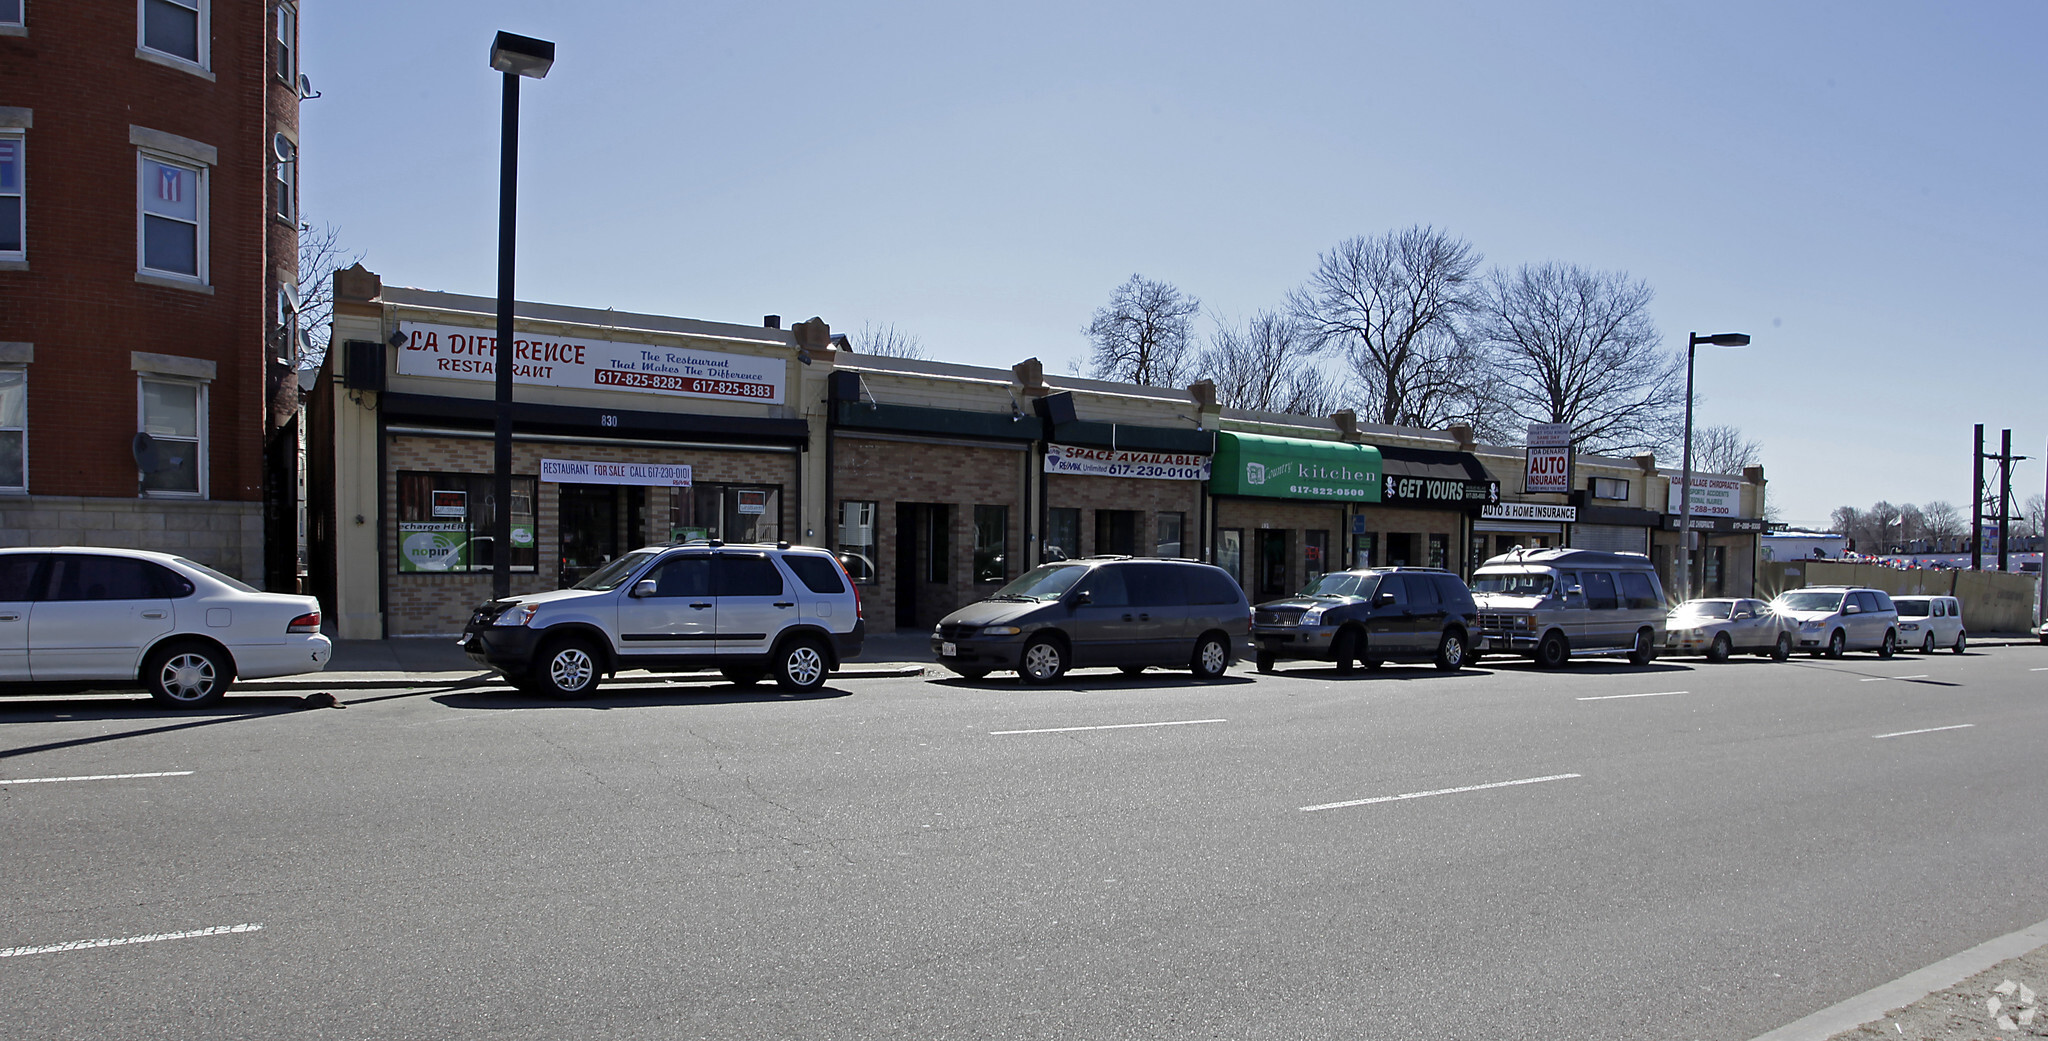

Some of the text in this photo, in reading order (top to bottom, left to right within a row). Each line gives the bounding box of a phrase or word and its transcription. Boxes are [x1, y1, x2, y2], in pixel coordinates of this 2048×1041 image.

[406, 330, 586, 365] LA DIFFRENCE
[437, 357, 553, 379] RESTARANT
[640, 350, 730, 368] The Restaurant
[610, 359, 764, 381] That Makes The Difference
[597, 370, 772, 398] 617-825-8282 617-825-8383
[601, 414, 618, 427] 830
[1065, 446, 1115, 462] SPACE
[1117, 450, 1201, 467] AVAILABLE
[1530, 455, 1566, 475] AUTO
[543, 461, 690, 479] RESTAURANT FOR SALE CALL 617-230-0101
[1082, 463, 1108, 473] Unlimited
[1298, 463, 1376, 482] kitchen
[1398, 478, 1464, 501] GET YOURS
[1528, 475, 1567, 486] INSURANCE
[1709, 480, 1739, 490] CHIROPRACTIC
[1289, 484, 1365, 497] 617-822-0500
[1482, 504, 1576, 519] AUTO & HOME INSURANCE
[1679, 505, 1729, 514] -288-9300
[411, 547, 449, 558] nopin
